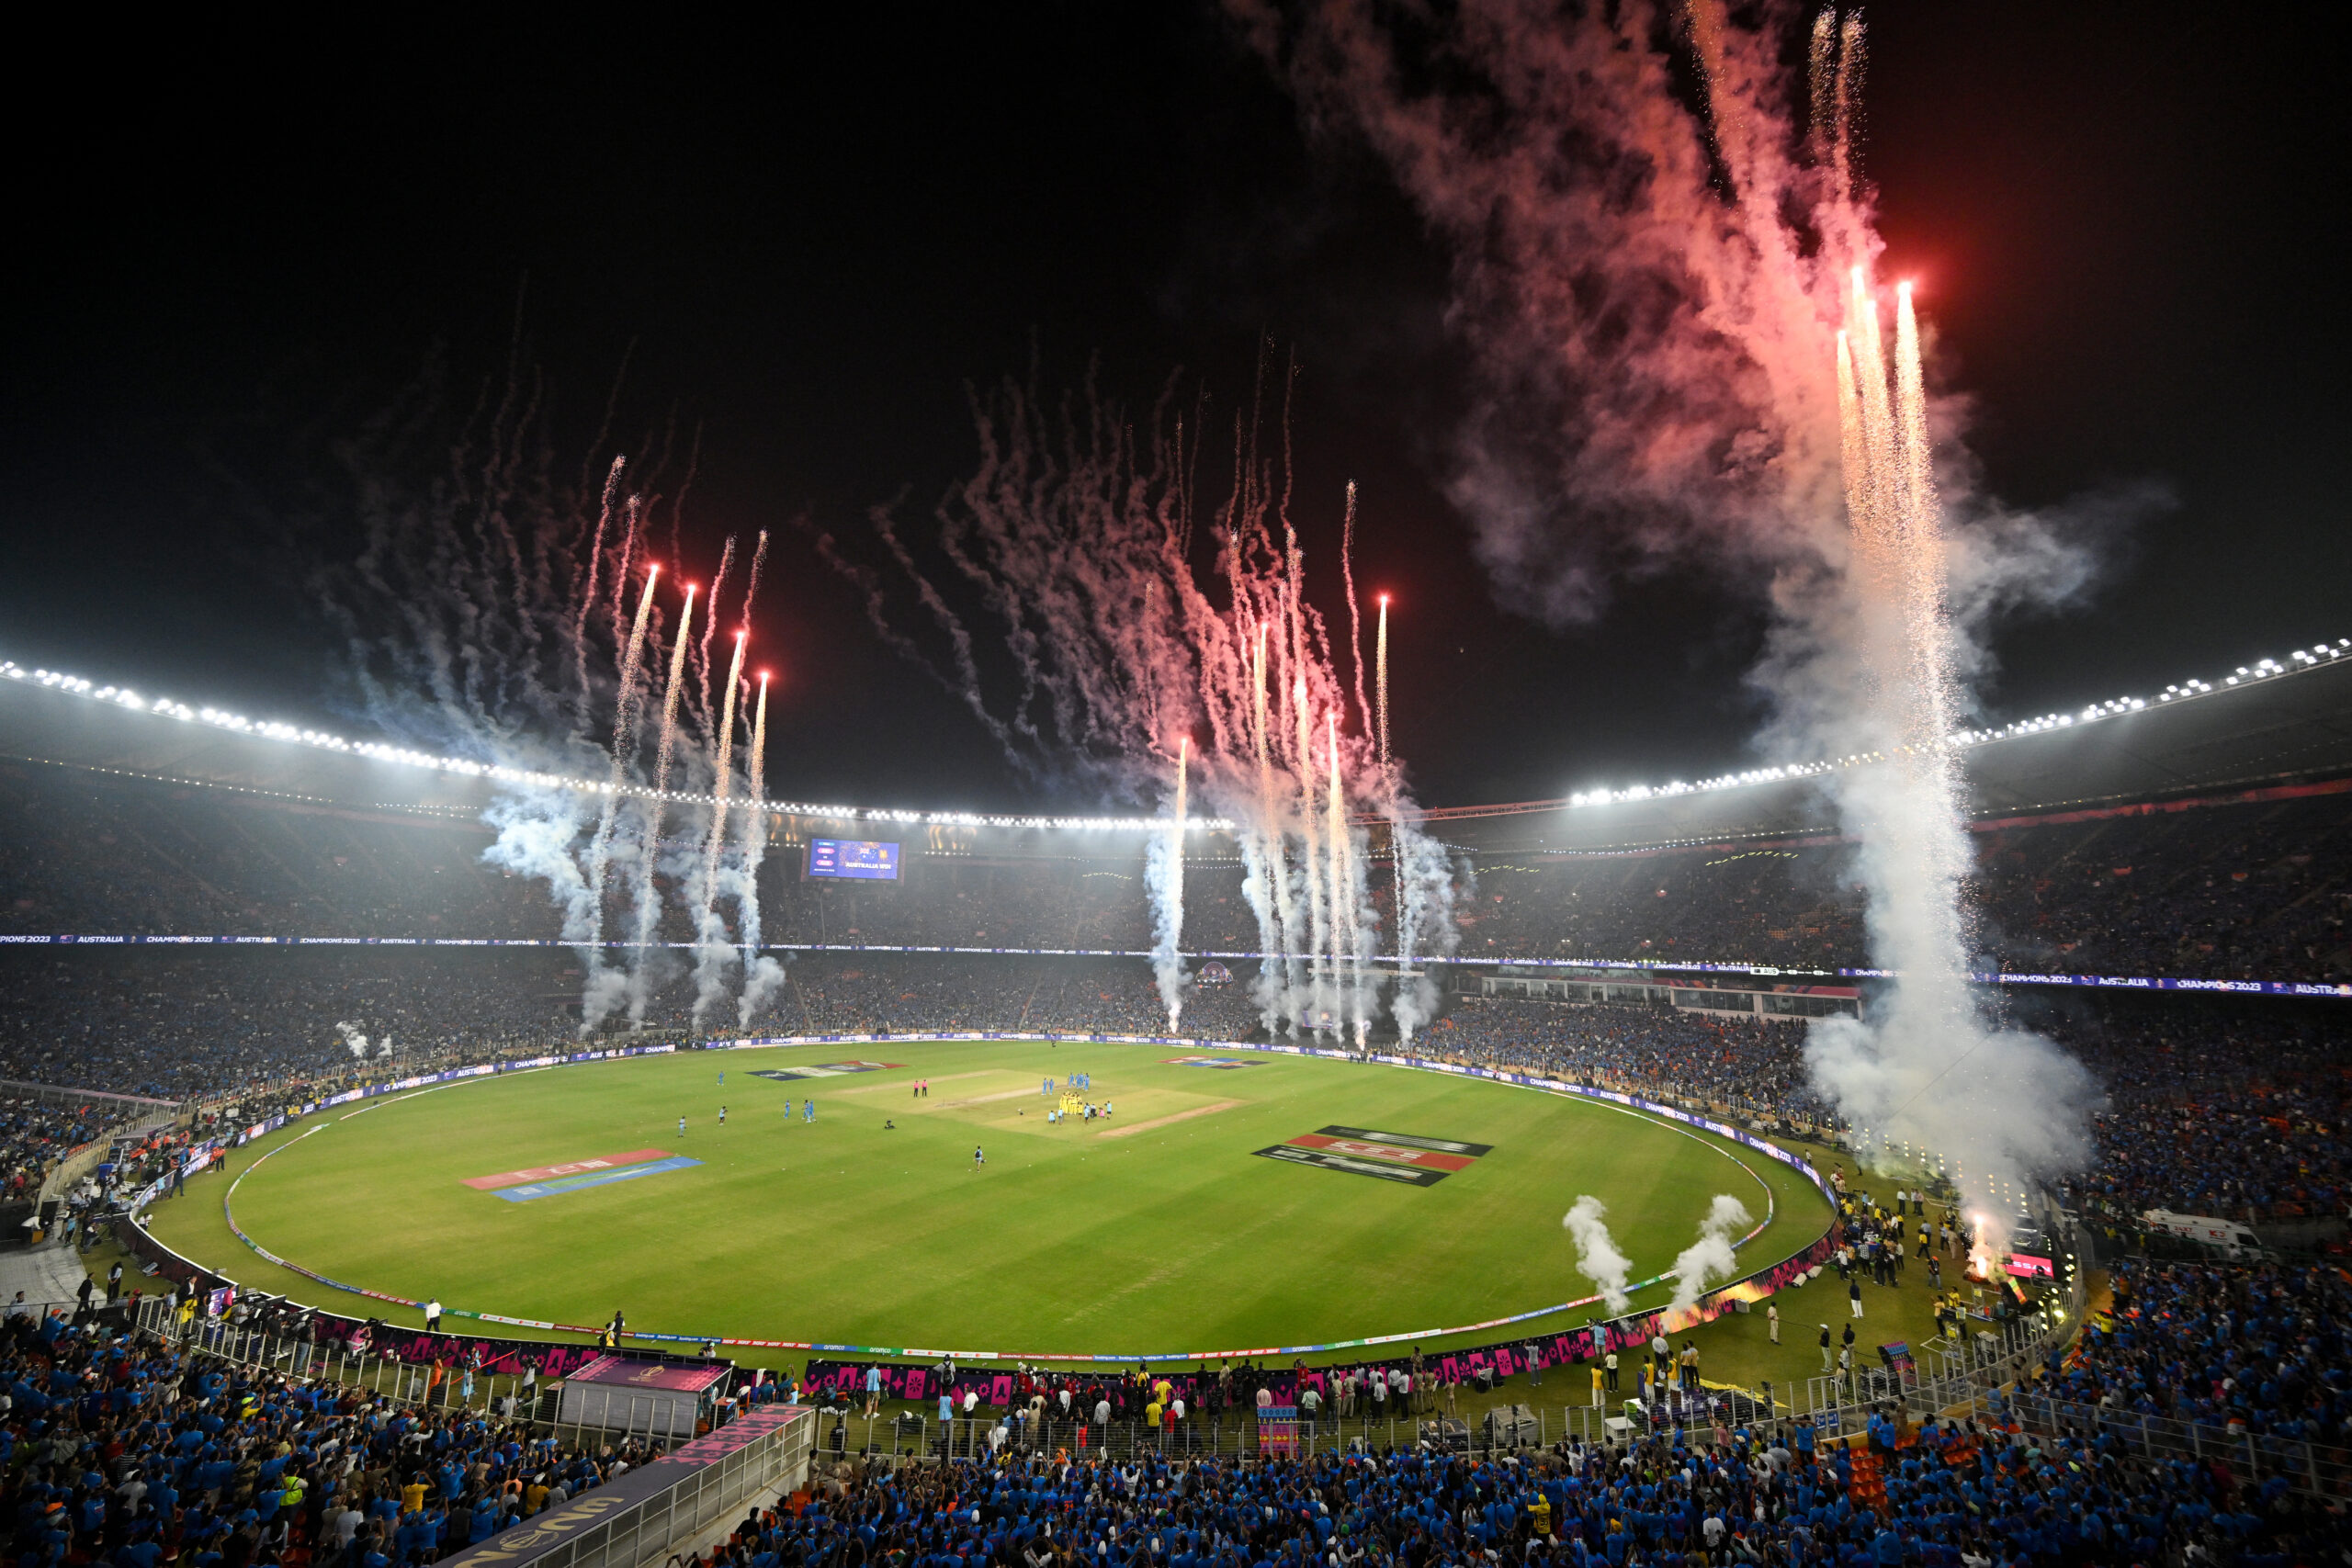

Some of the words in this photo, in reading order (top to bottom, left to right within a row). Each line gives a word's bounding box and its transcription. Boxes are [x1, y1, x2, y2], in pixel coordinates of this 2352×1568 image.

[2177, 980, 2235, 990] CHAMPIONS
[2235, 981, 2261, 991] 2023
[515, 1056, 553, 1068] CHAMPIONS
[457, 1065, 494, 1077] AUSTRALIA
[384, 1077, 422, 1091] CAMPIONS
[422, 1074, 438, 1084] 2023
[1530, 1078, 1565, 1091] CHAMPIONS
[1565, 1083, 1581, 1093] 2023
[330, 1089, 364, 1105] AUSTRALIA
[1600, 1090, 1631, 1105] AUSTRALIA
[1645, 1102, 1677, 1119] CHAMPIONS
[1676, 1110, 1690, 1122] 2023
[1705, 1120, 1736, 1139] AUSTRALIA
[1749, 1136, 1779, 1158] CHAMPIONS
[1778, 1149, 1792, 1164] 2023
